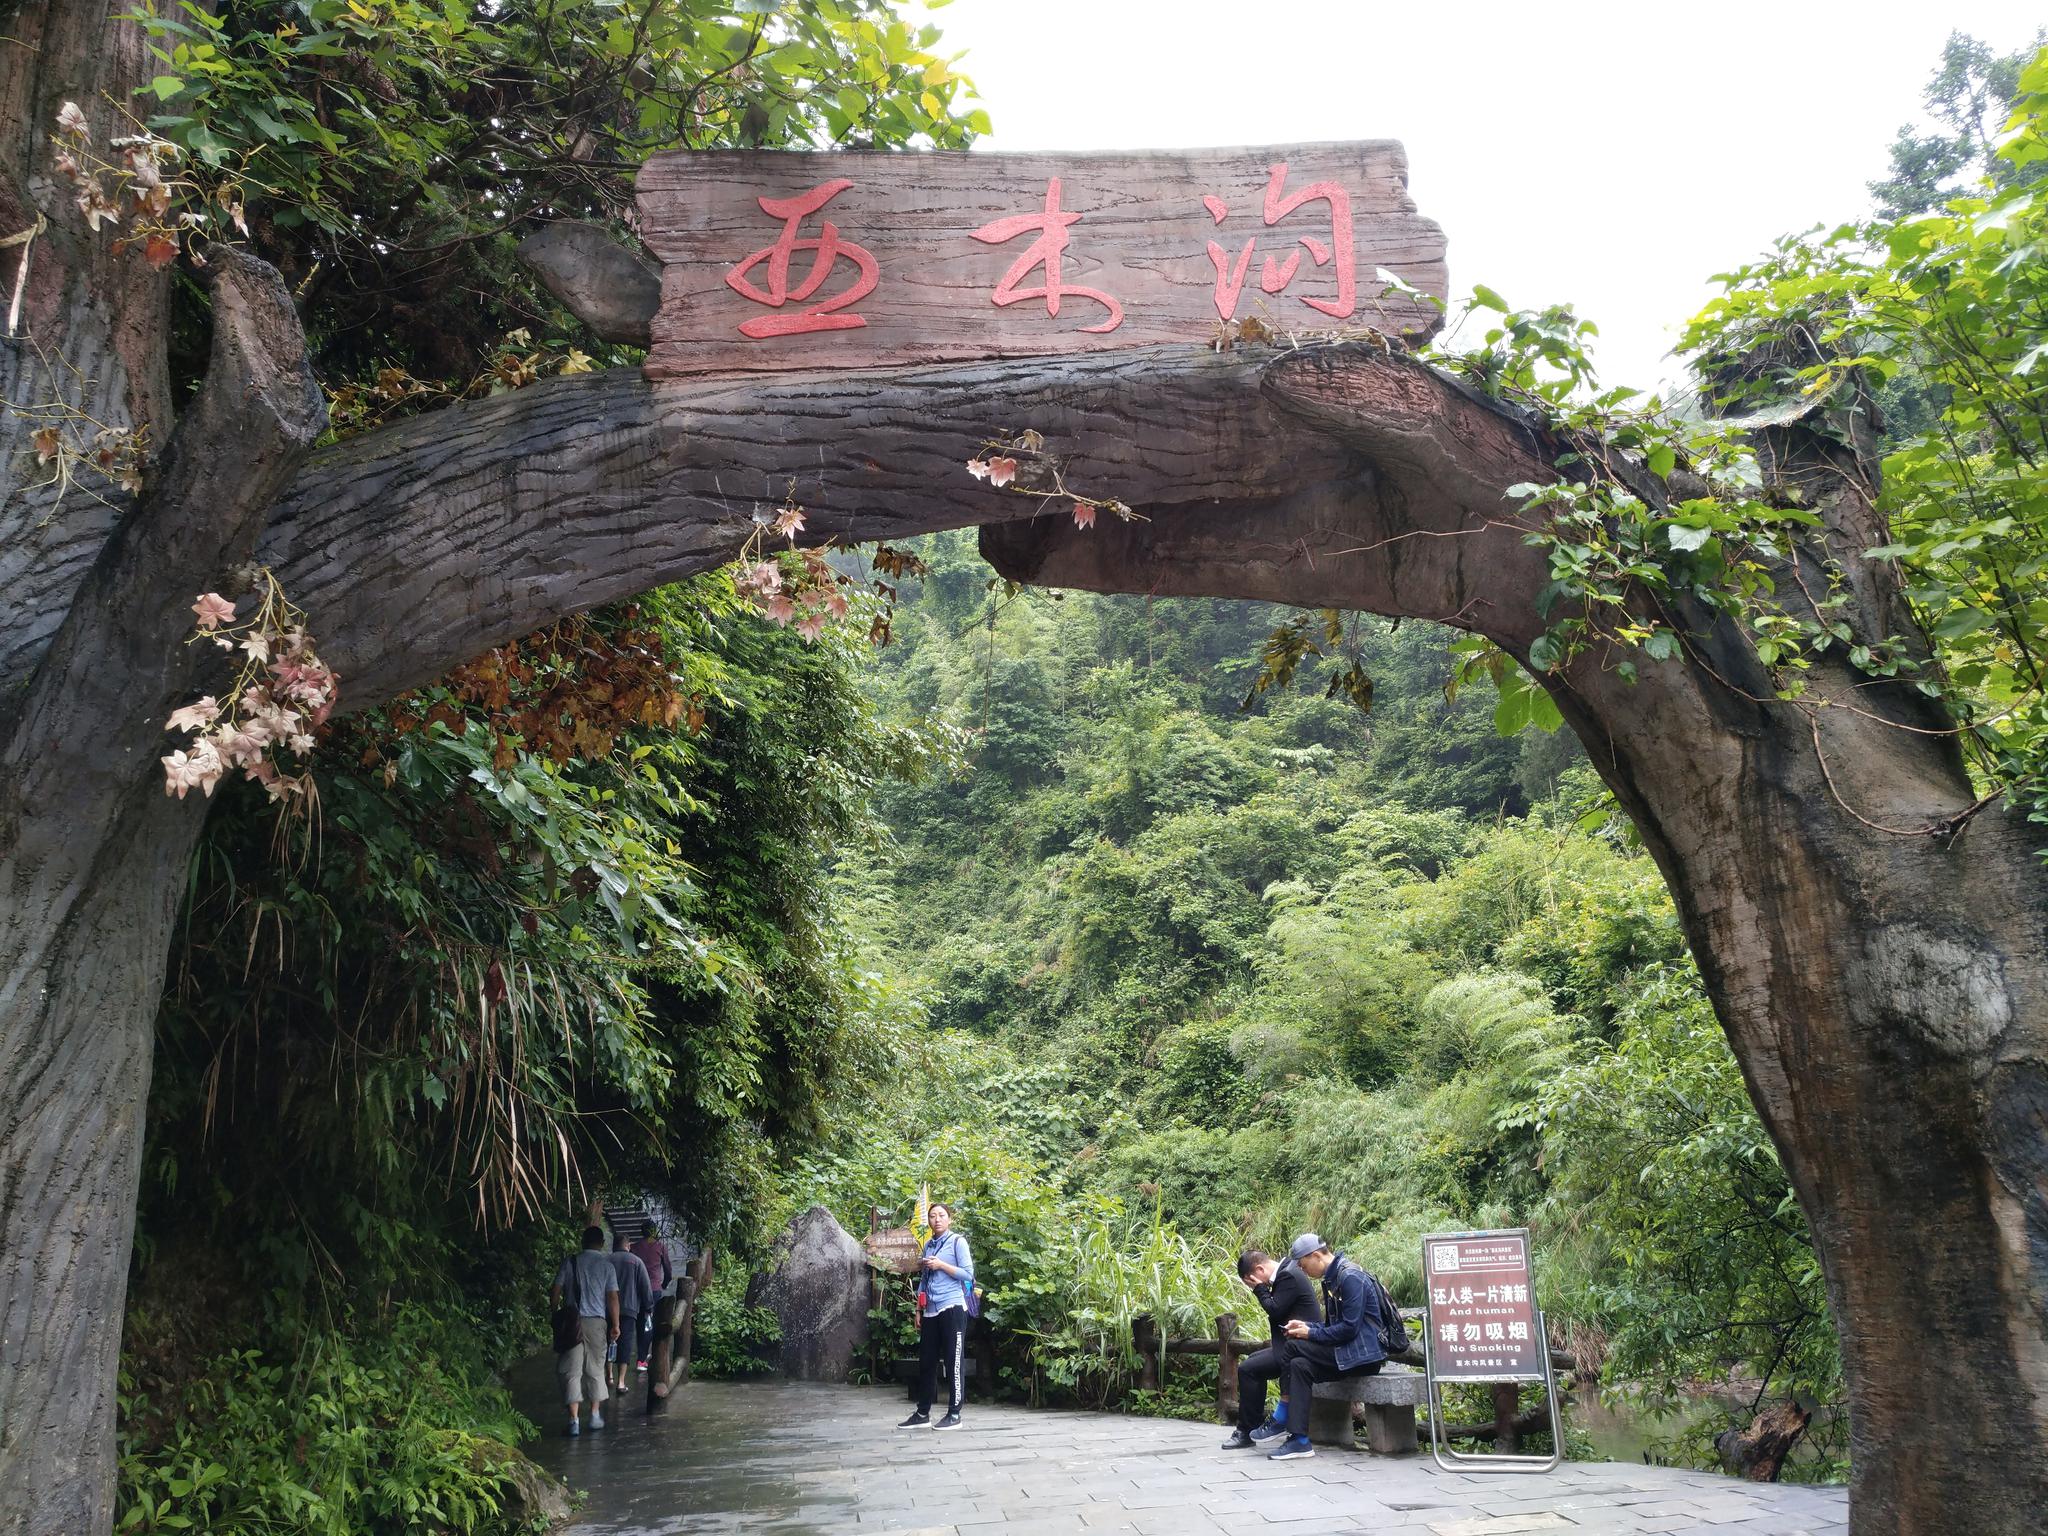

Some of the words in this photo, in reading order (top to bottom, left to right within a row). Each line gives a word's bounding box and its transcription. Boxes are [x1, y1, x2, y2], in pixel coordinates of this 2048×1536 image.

[1433, 1284, 1527, 1305] 还人类一片清新
[1449, 1308, 1472, 1316] And
[1476, 1307, 1515, 1315] human
[1440, 1321, 1528, 1342] 请勿吸烟
[1470, 1344, 1521, 1352] Smoking
